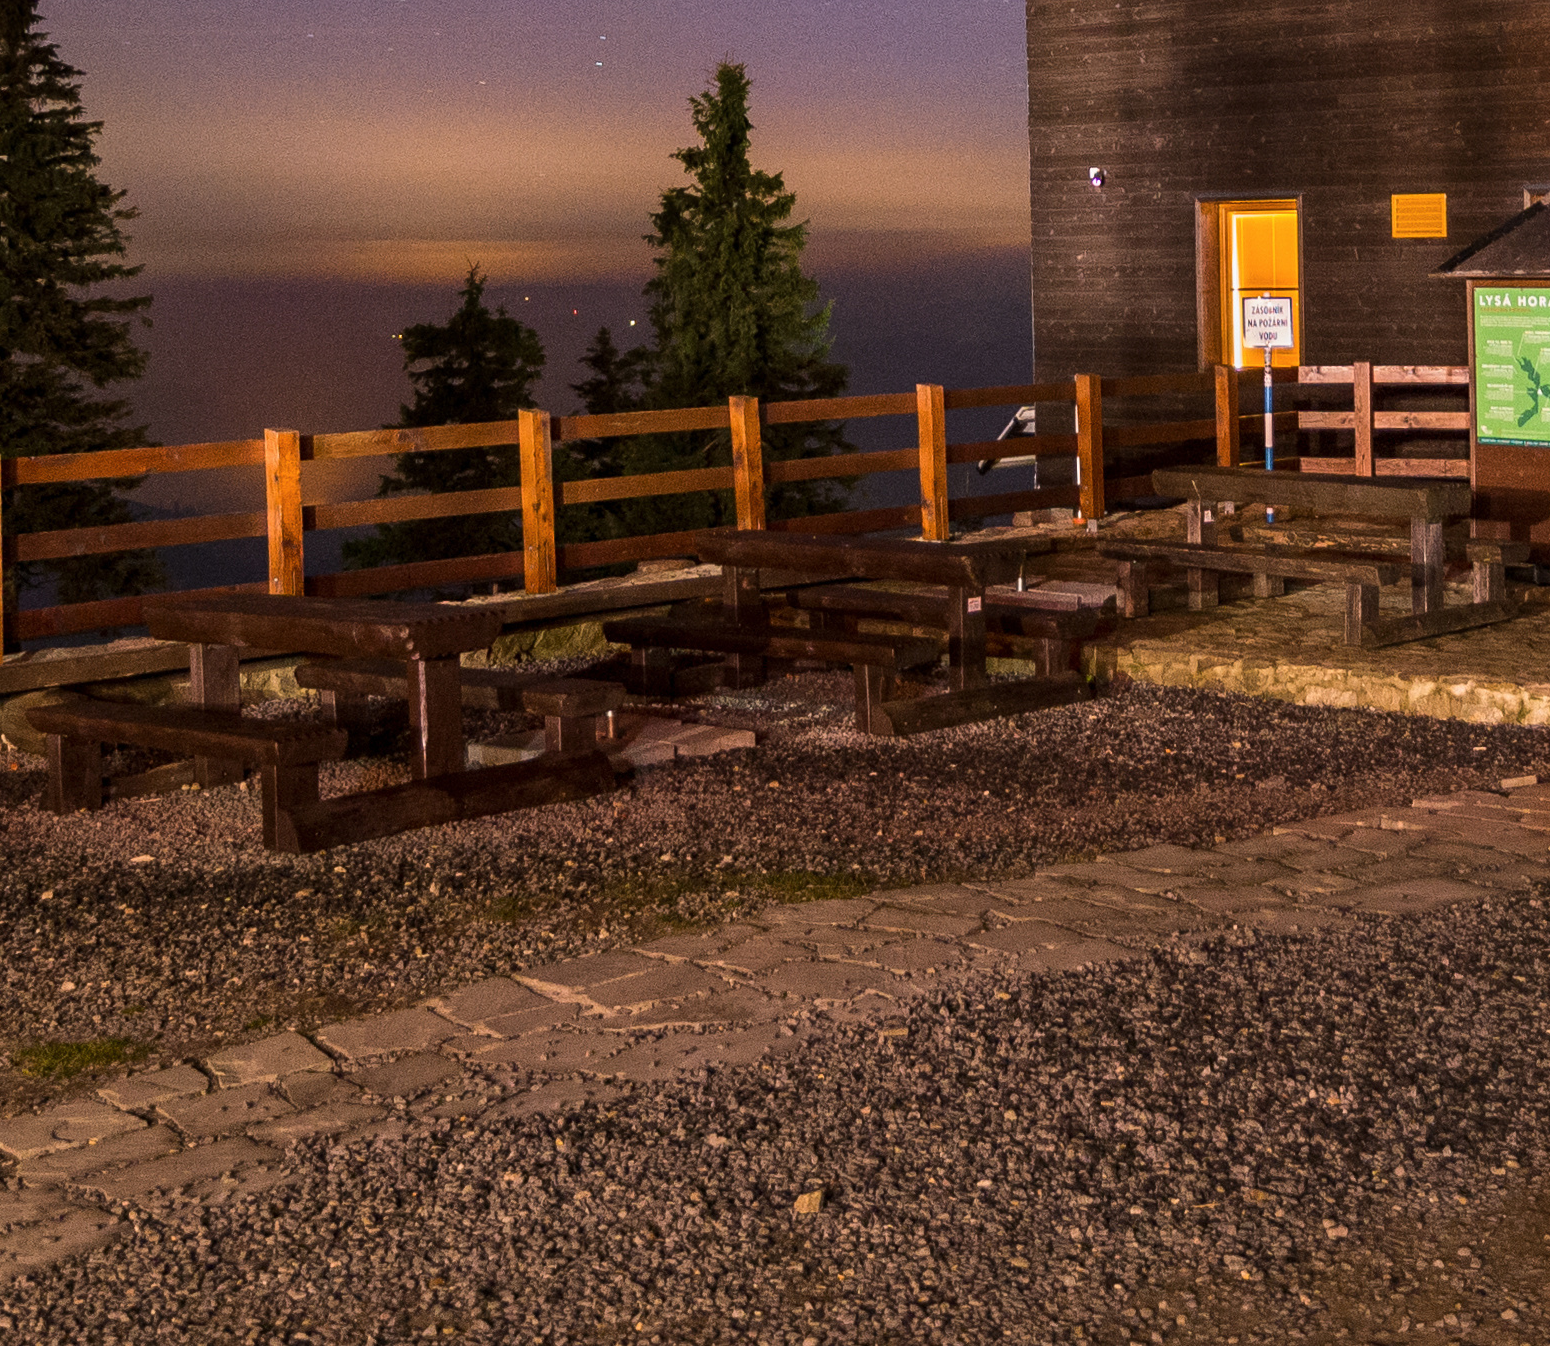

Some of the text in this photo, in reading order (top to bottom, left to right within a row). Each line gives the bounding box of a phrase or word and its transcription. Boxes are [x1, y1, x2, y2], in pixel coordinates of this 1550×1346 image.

[1479, 292, 1512, 307] LYSÁ
[1247, 319, 1257, 327] NA
[1259, 331, 1278, 340] VODU
